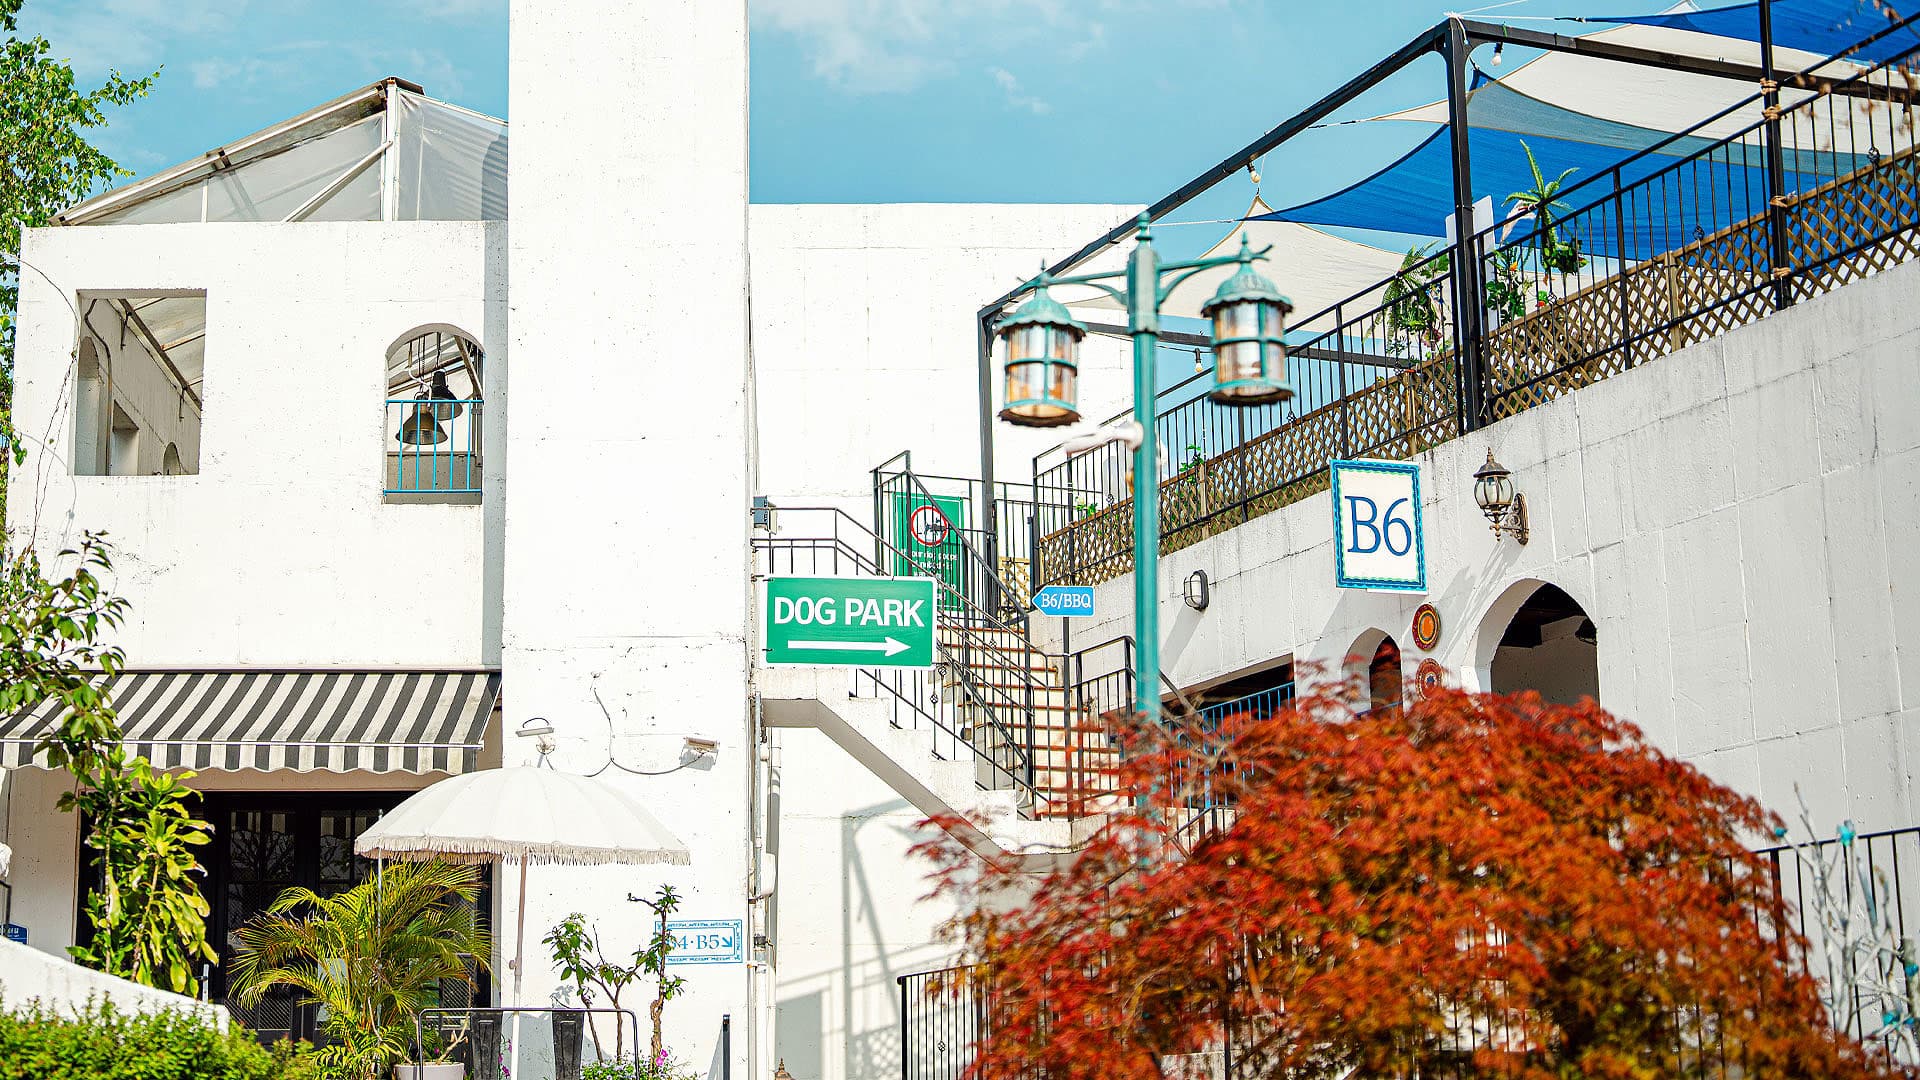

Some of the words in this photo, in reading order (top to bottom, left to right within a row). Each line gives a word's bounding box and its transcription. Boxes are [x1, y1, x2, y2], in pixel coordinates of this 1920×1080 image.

[1344, 495, 1412, 557] B6
[774, 596, 837, 625] DOG
[844, 597, 925, 627] PARK
[1041, 593, 1091, 609] B6/BBQ
